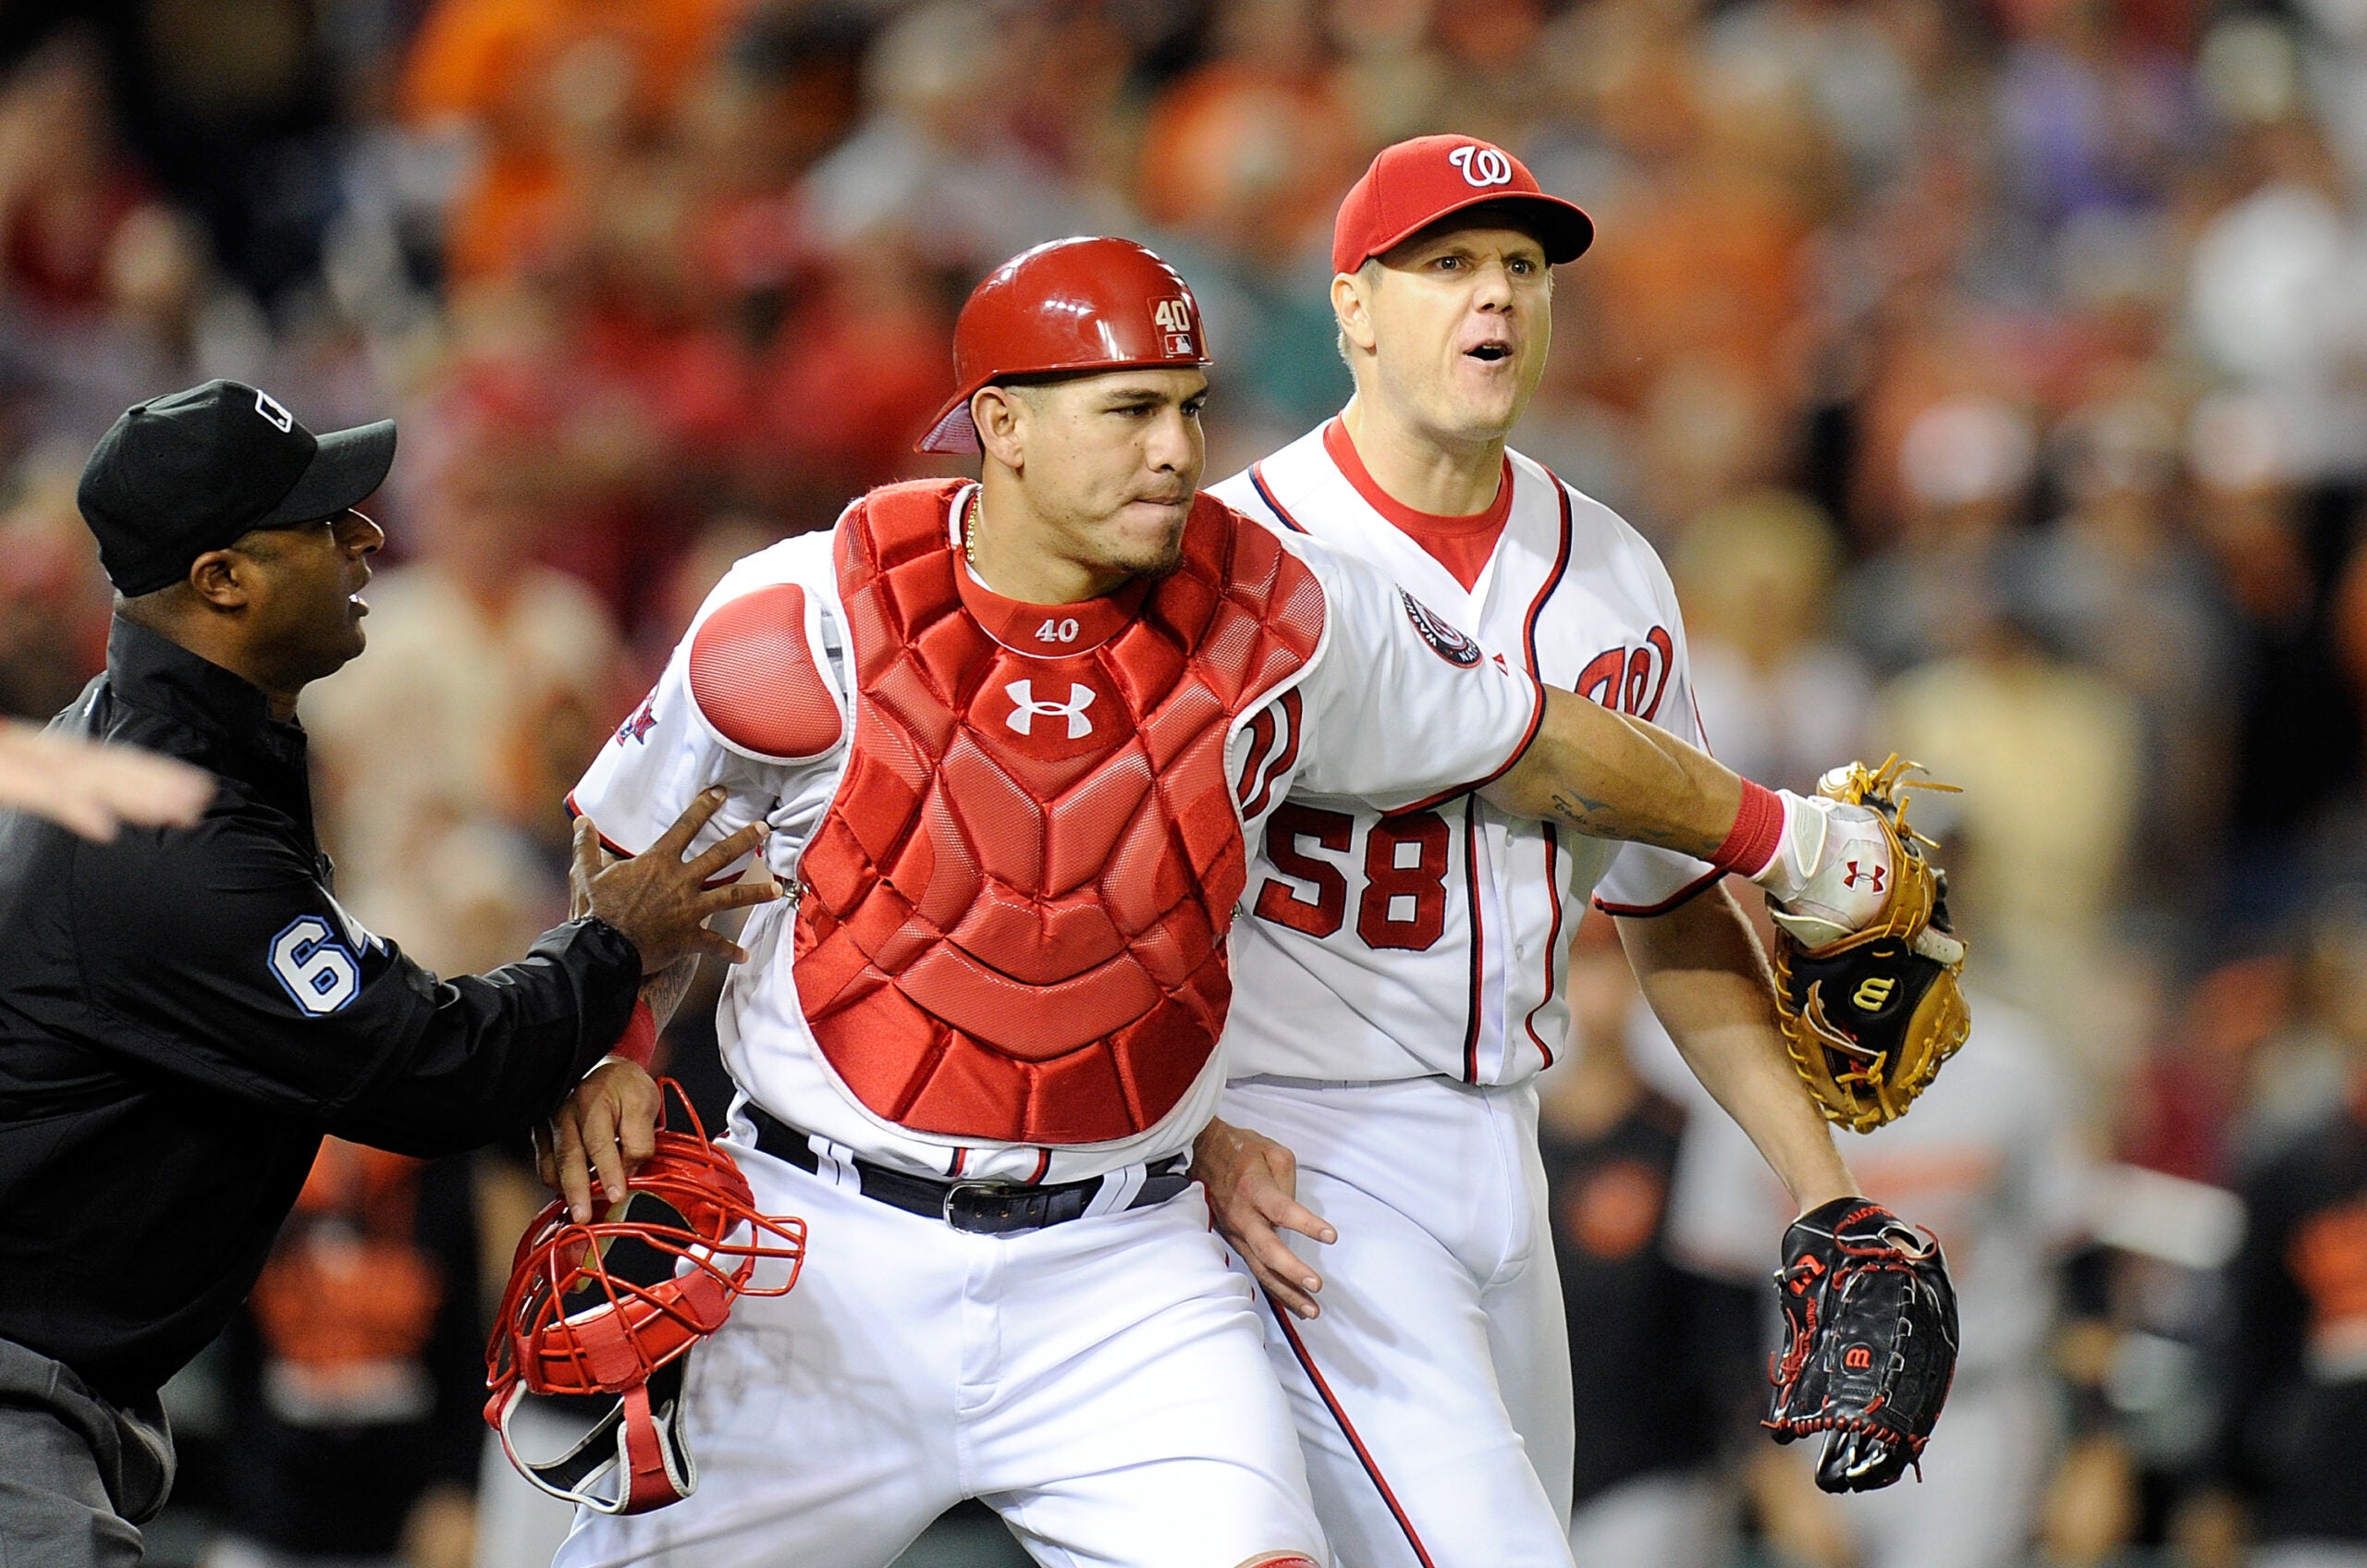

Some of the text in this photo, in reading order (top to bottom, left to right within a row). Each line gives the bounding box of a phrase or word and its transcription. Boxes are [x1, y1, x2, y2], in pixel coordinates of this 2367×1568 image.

[1447, 145, 1512, 188] W
[1155, 300, 1190, 332] 40
[1035, 618, 1079, 643] 40
[1253, 802, 1451, 951] 58
